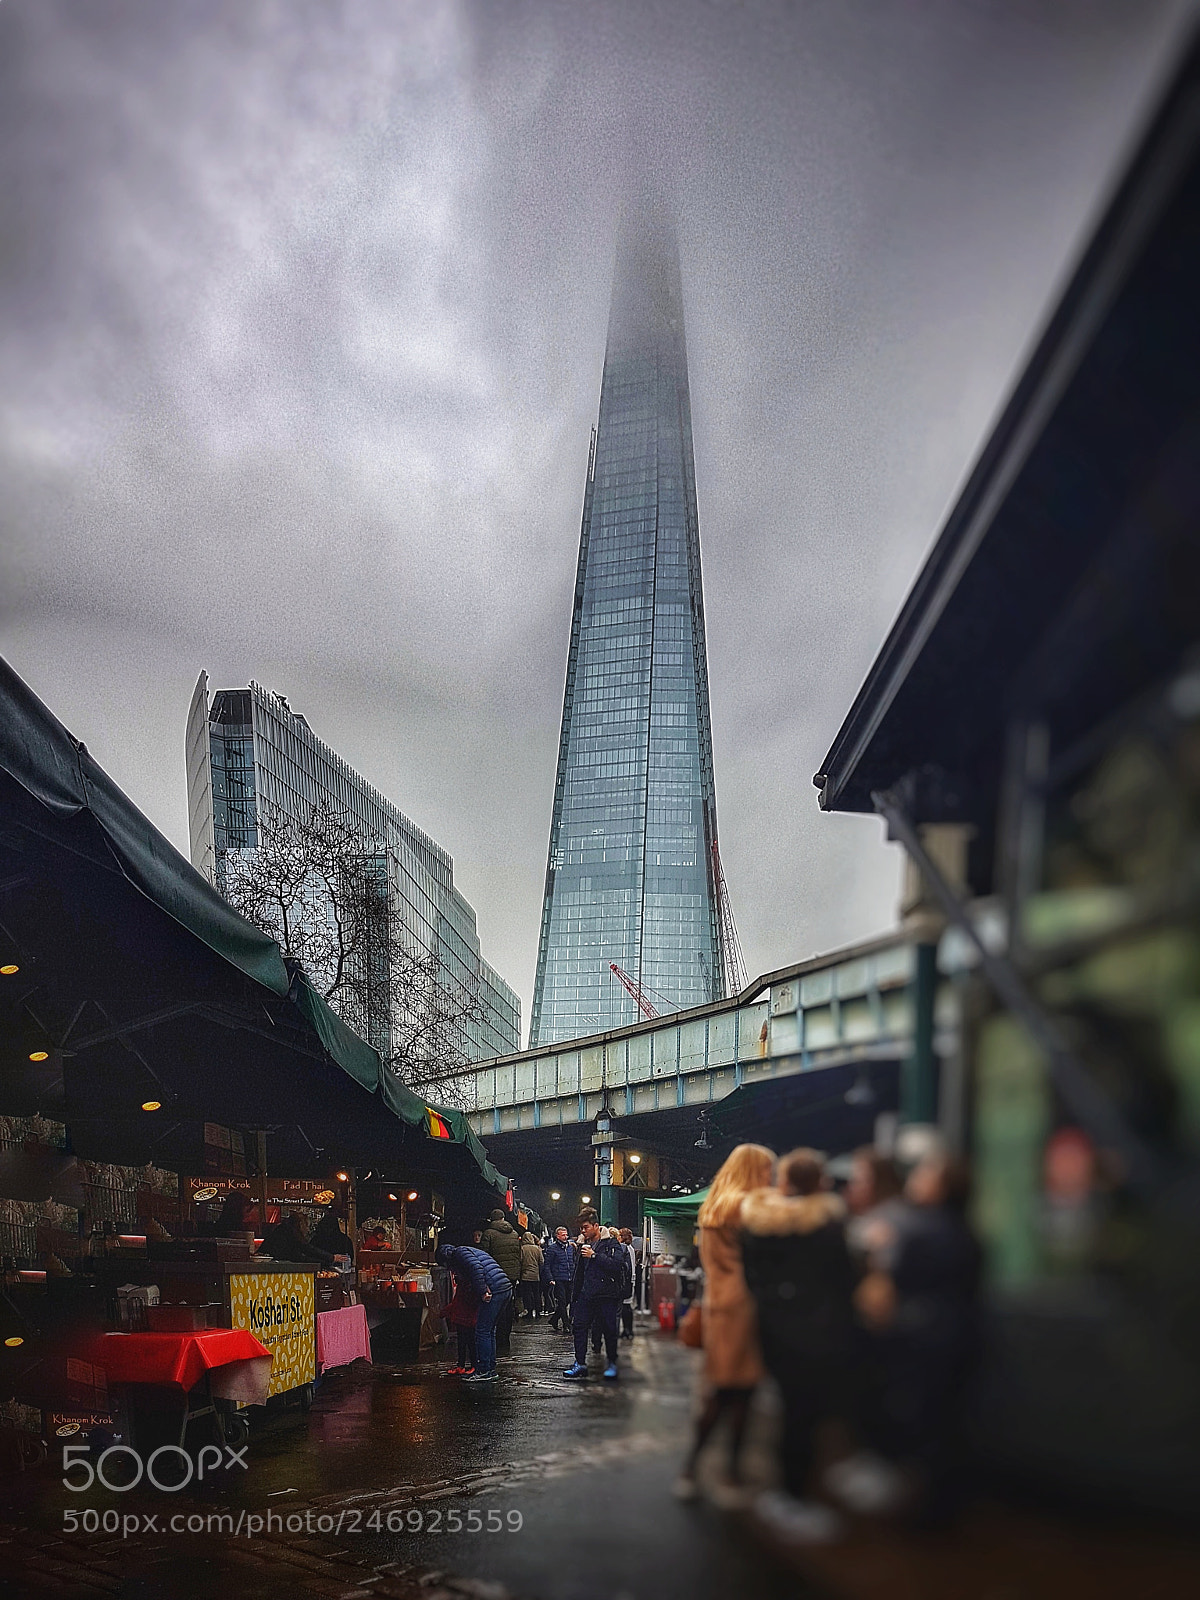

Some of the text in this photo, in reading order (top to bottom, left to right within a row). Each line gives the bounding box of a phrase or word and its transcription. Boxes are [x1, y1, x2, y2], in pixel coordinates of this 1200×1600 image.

[190, 1178, 251, 1189] Khanom Krok
[283, 1180, 325, 1191] Pad Thai
[249, 1296, 303, 1330] Koshari St.
[52, 1414, 114, 1425] Khanom Krok
